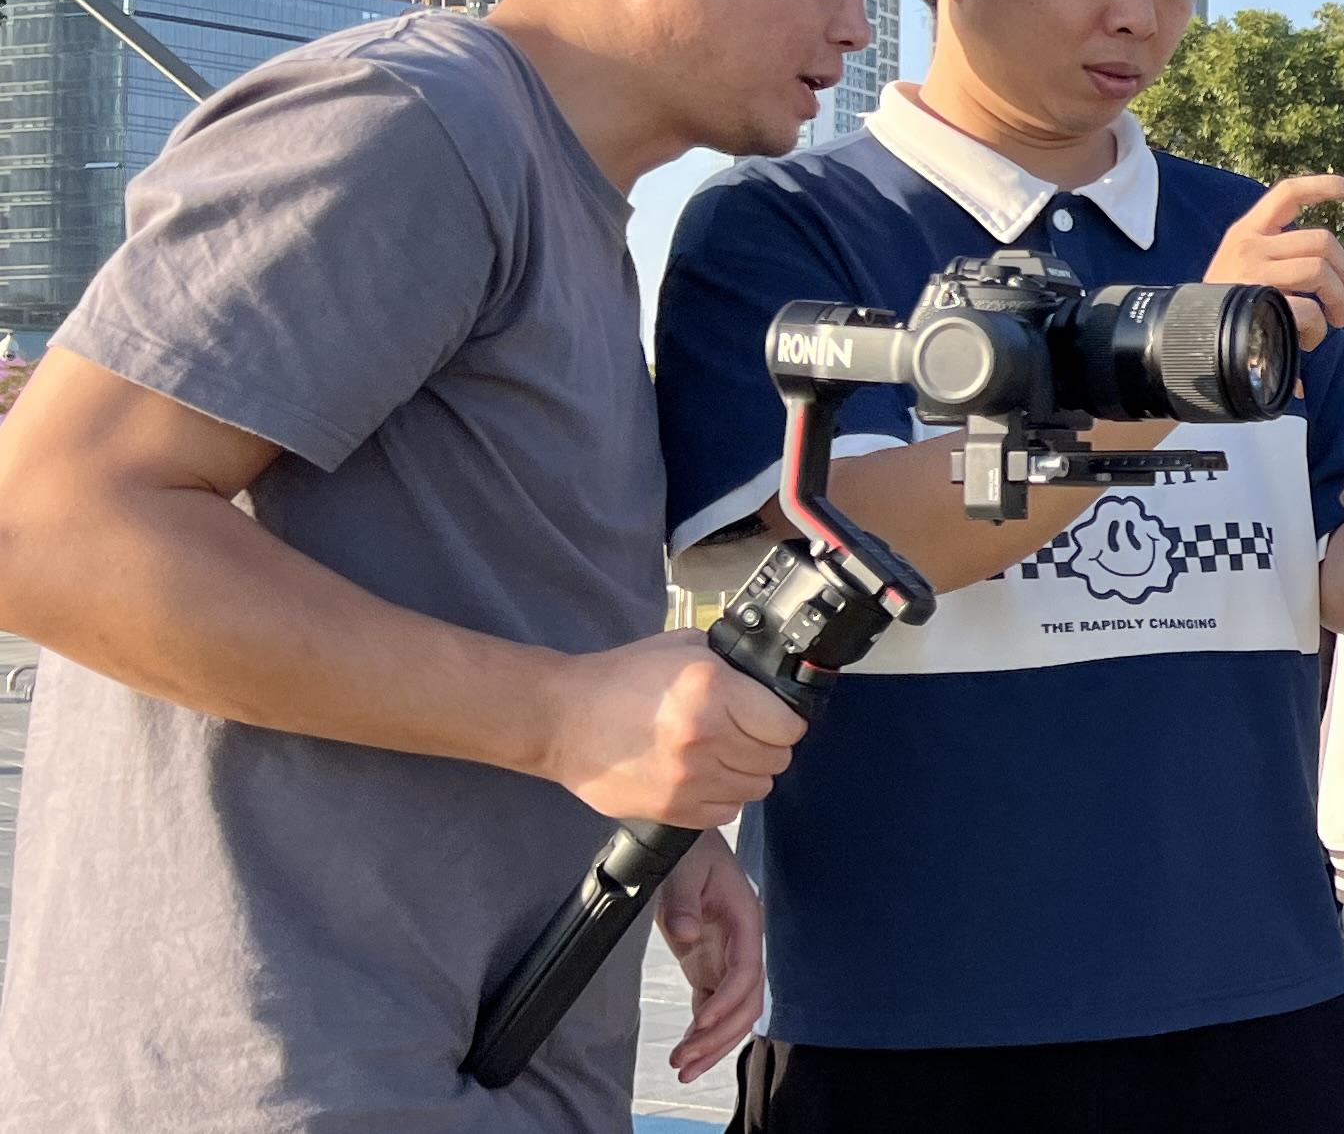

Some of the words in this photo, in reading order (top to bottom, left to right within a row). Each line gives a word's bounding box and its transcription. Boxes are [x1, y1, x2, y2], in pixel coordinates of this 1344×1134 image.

[778, 333, 853, 368] RONIN
[1041, 622, 1074, 633] THE
[1080, 618, 1144, 632] RAPIDLY
[1150, 618, 1217, 629] CHANGING
